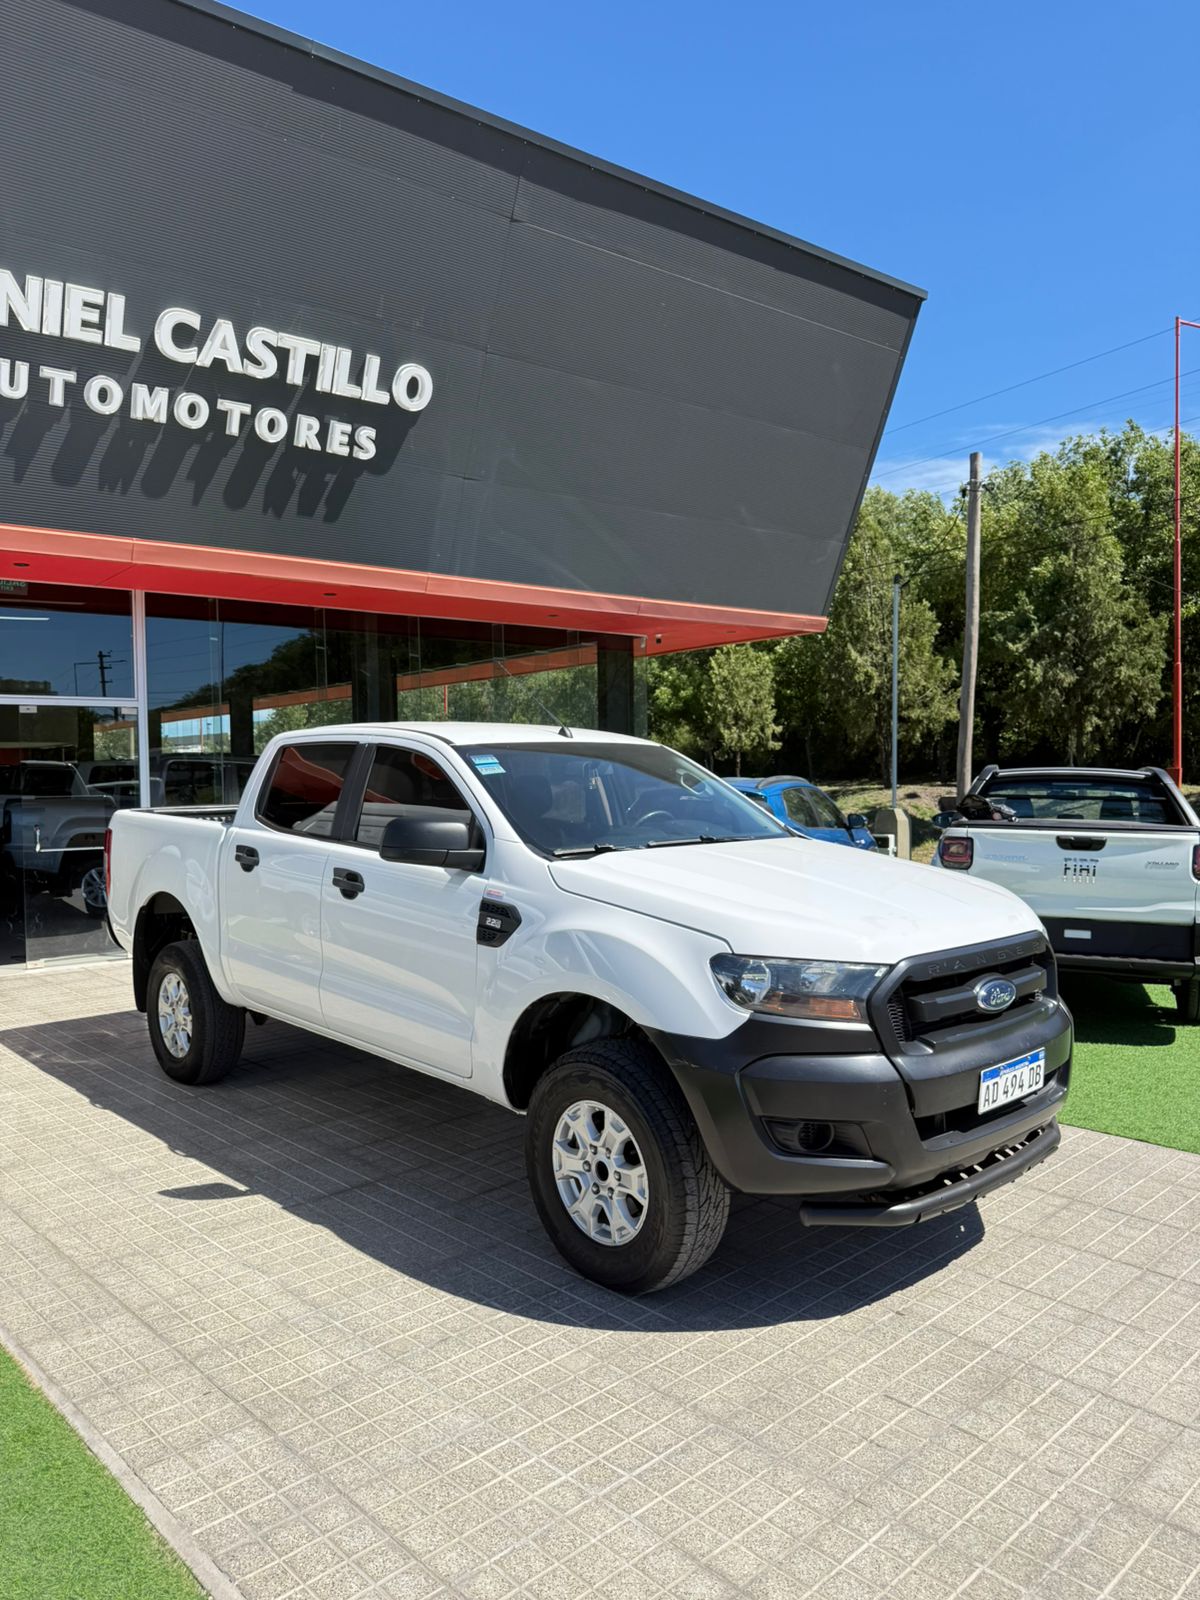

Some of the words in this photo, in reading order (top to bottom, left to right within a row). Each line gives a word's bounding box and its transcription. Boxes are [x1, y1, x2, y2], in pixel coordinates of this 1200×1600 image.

[0, 268, 141, 353] NIEL
[154, 307, 433, 412] CASTILLO
[0, 358, 377, 460] UTOMOTORES
[983, 1080, 999, 1108] AD
[1003, 1070, 1024, 1099] 494
[1028, 1064, 1042, 1089] DB
